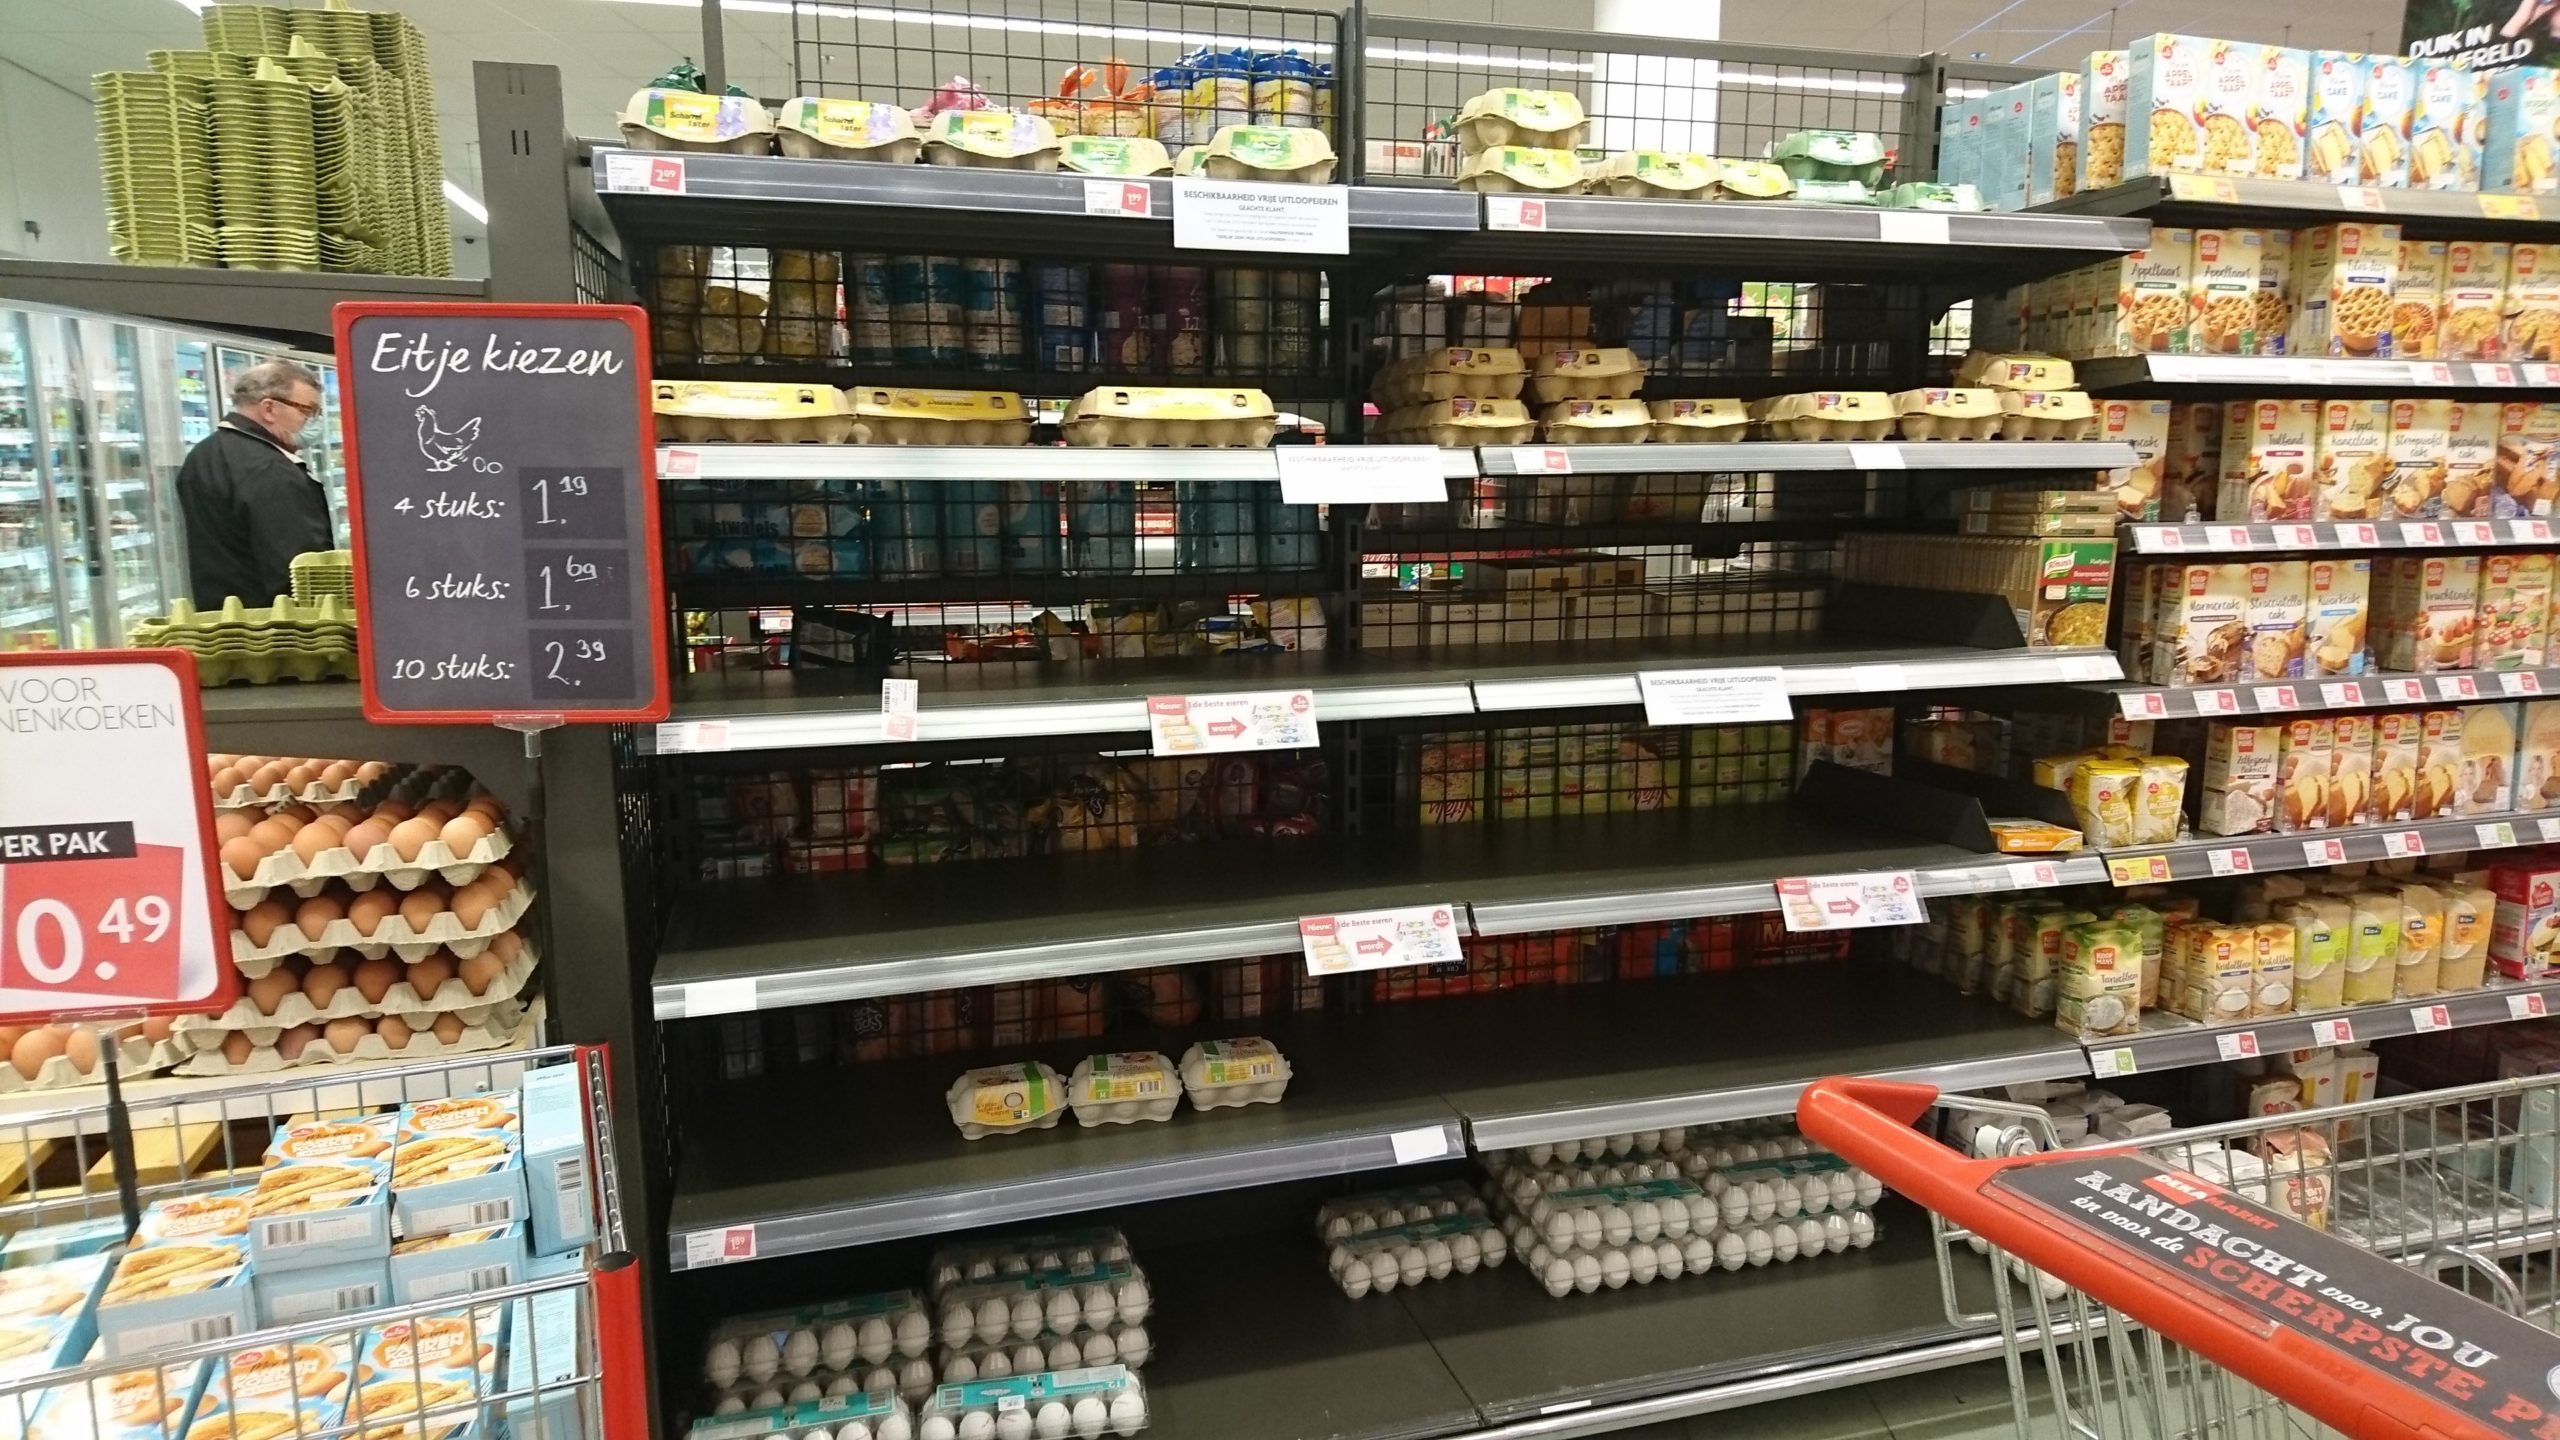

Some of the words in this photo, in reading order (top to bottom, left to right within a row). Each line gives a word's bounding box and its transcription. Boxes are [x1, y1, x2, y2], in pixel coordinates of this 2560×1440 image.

[2409, 32, 2463, 59] DUIK
[2465, 24, 2493, 46] IN
[2327, 87, 2347, 96] CAKE
[2377, 91, 2398, 100] CAKE
[655, 169, 677, 182] 2.09
[1183, 190, 1256, 203] BESCHIKBAARHEID
[1257, 194, 1277, 204] VRIJE
[1278, 195, 1339, 206] UITLOOPEIEREN
[2131, 262, 2183, 278] Appeltaart
[371, 332, 472, 398] Eitje
[482, 333, 623, 377] kiezen
[393, 497, 415, 516] 4
[420, 491, 505, 519] stuks:
[405, 576, 420, 598] 6
[426, 572, 511, 600] stuks:
[391, 659, 425, 680] 10
[430, 653, 515, 681] stuks:
[1226, 698, 1249, 708] eieren
[1211, 723, 1238, 733] wordt
[49, 830, 109, 854] PAK
[1341, 920, 1351, 928] de
[1352, 918, 1371, 927] Beste
[1371, 917, 1393, 926] eieren
[1359, 942, 1385, 951] wordt
[2095, 951, 2113, 959] KOOP
[2152, 1174, 2209, 1200] DEKA
[2204, 1194, 2279, 1231] MARKT
[730, 1236, 746, 1251] 1.89
[2074, 1170, 2327, 1288] AANDACHT
[2317, 1286, 2384, 1319] voor
[2386, 1313, 2499, 1368] JOU
[2098, 1210, 2151, 1239] voor
[2150, 1236, 2185, 1254] de
[2183, 1246, 2487, 1401] SCHERPSTE
